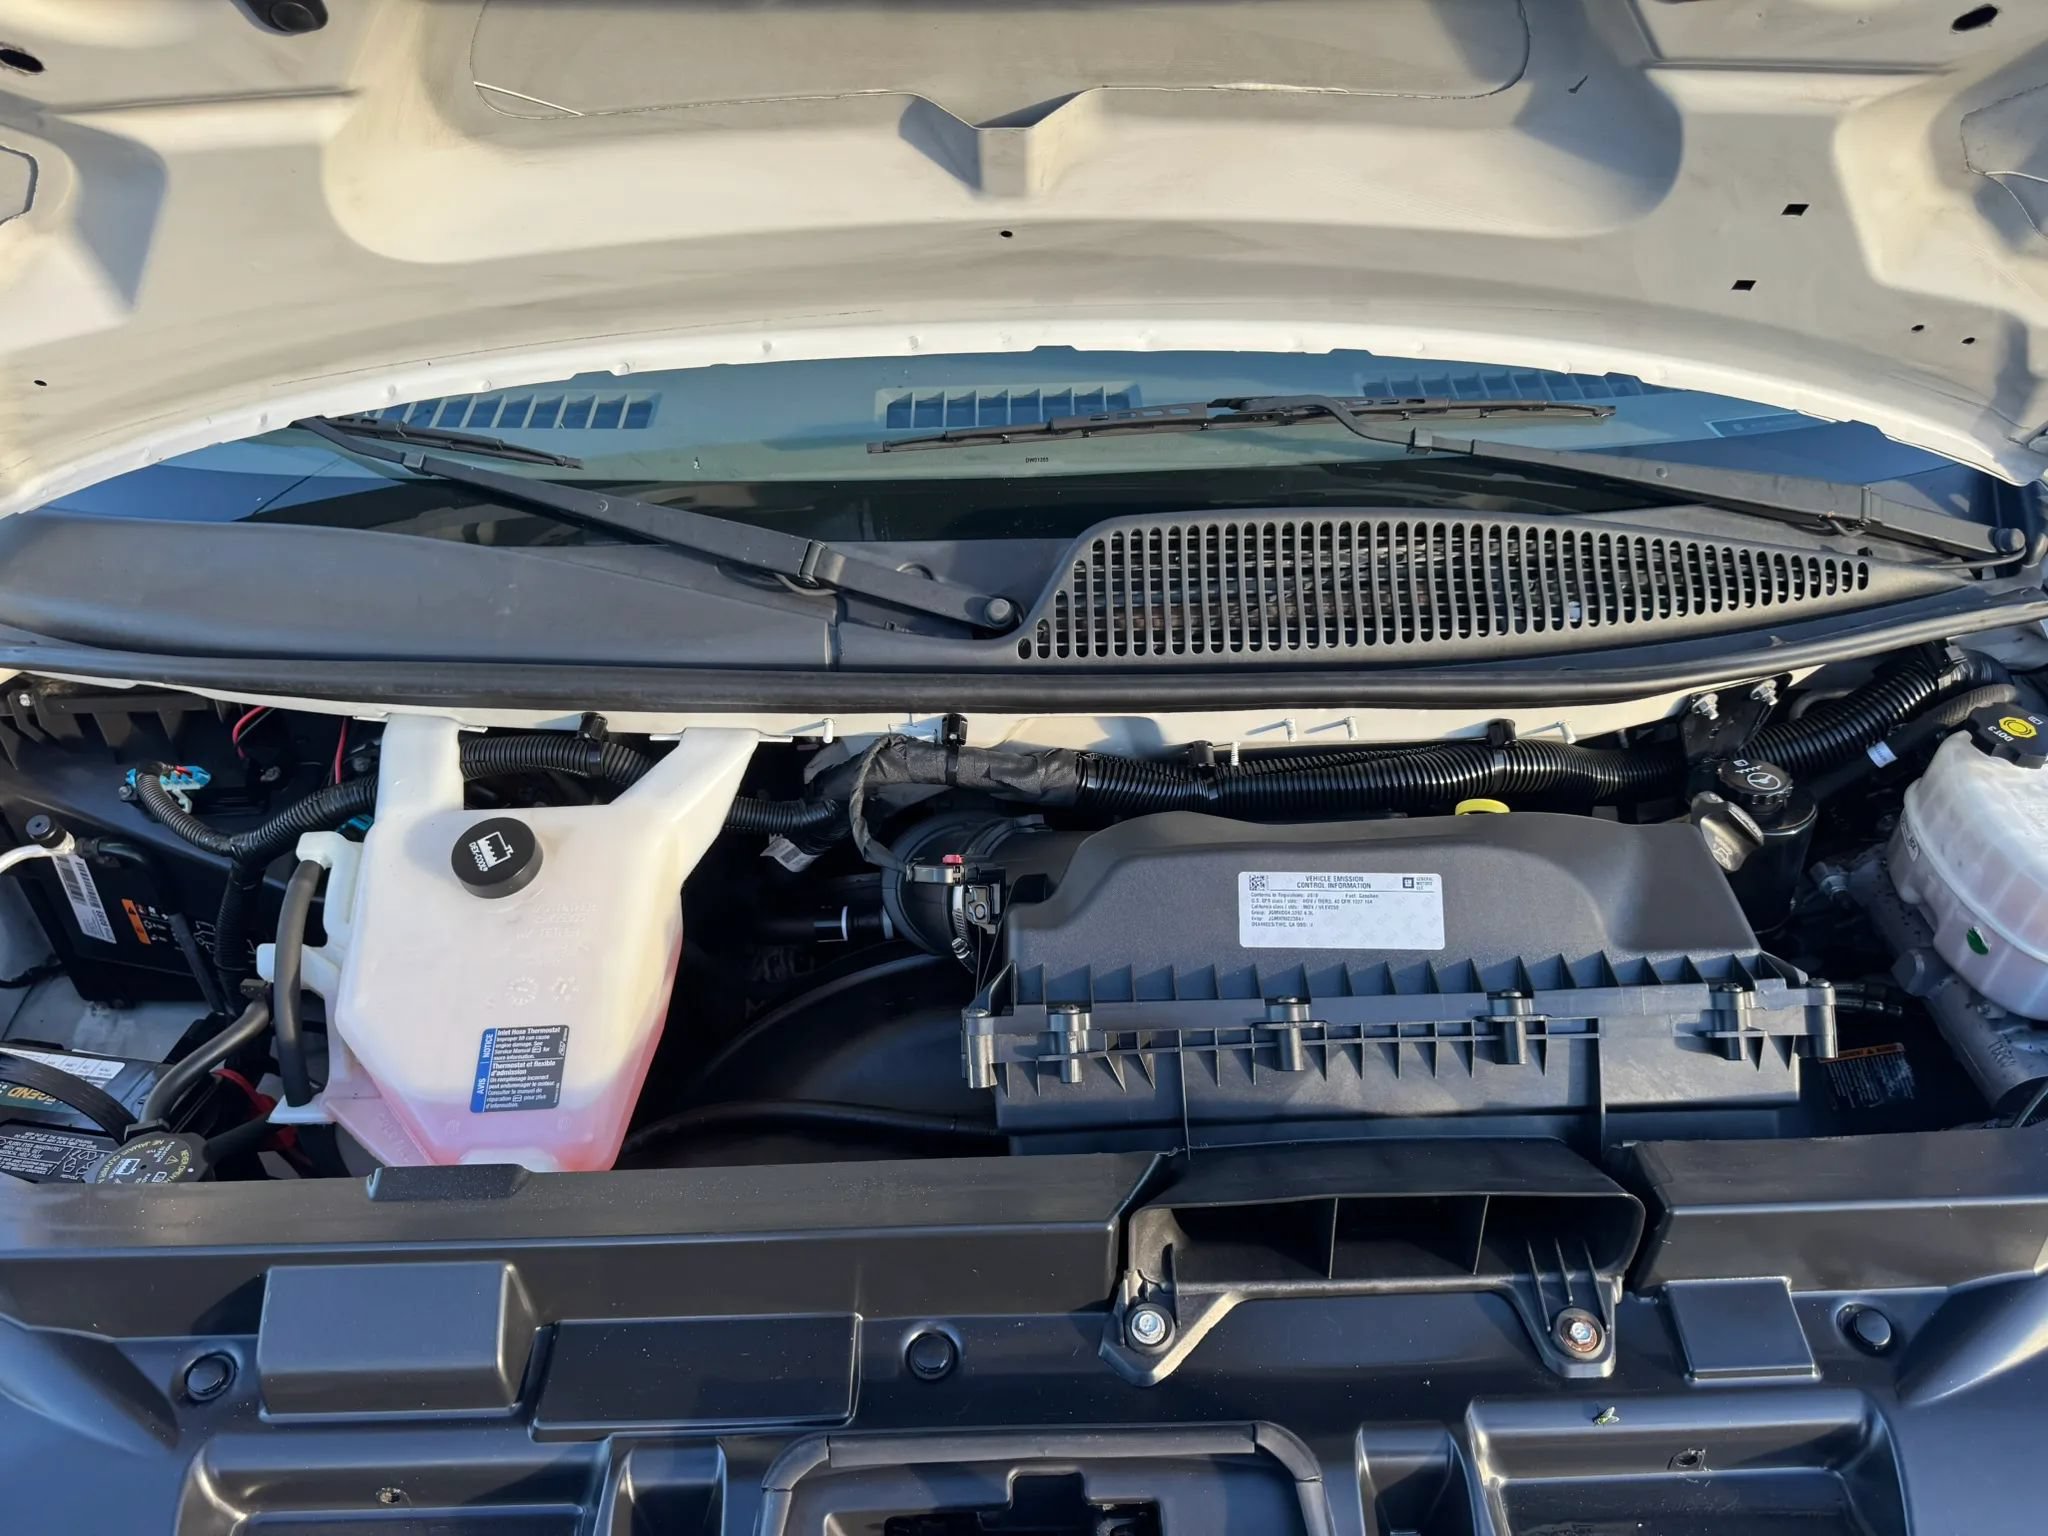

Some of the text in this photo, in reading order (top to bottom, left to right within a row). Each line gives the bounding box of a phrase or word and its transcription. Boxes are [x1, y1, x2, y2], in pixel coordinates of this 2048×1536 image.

[1993, 730, 2014, 741] DOT
[482, 1034, 494, 1058] NOTICE
[476, 1078, 486, 1094] AVIS
